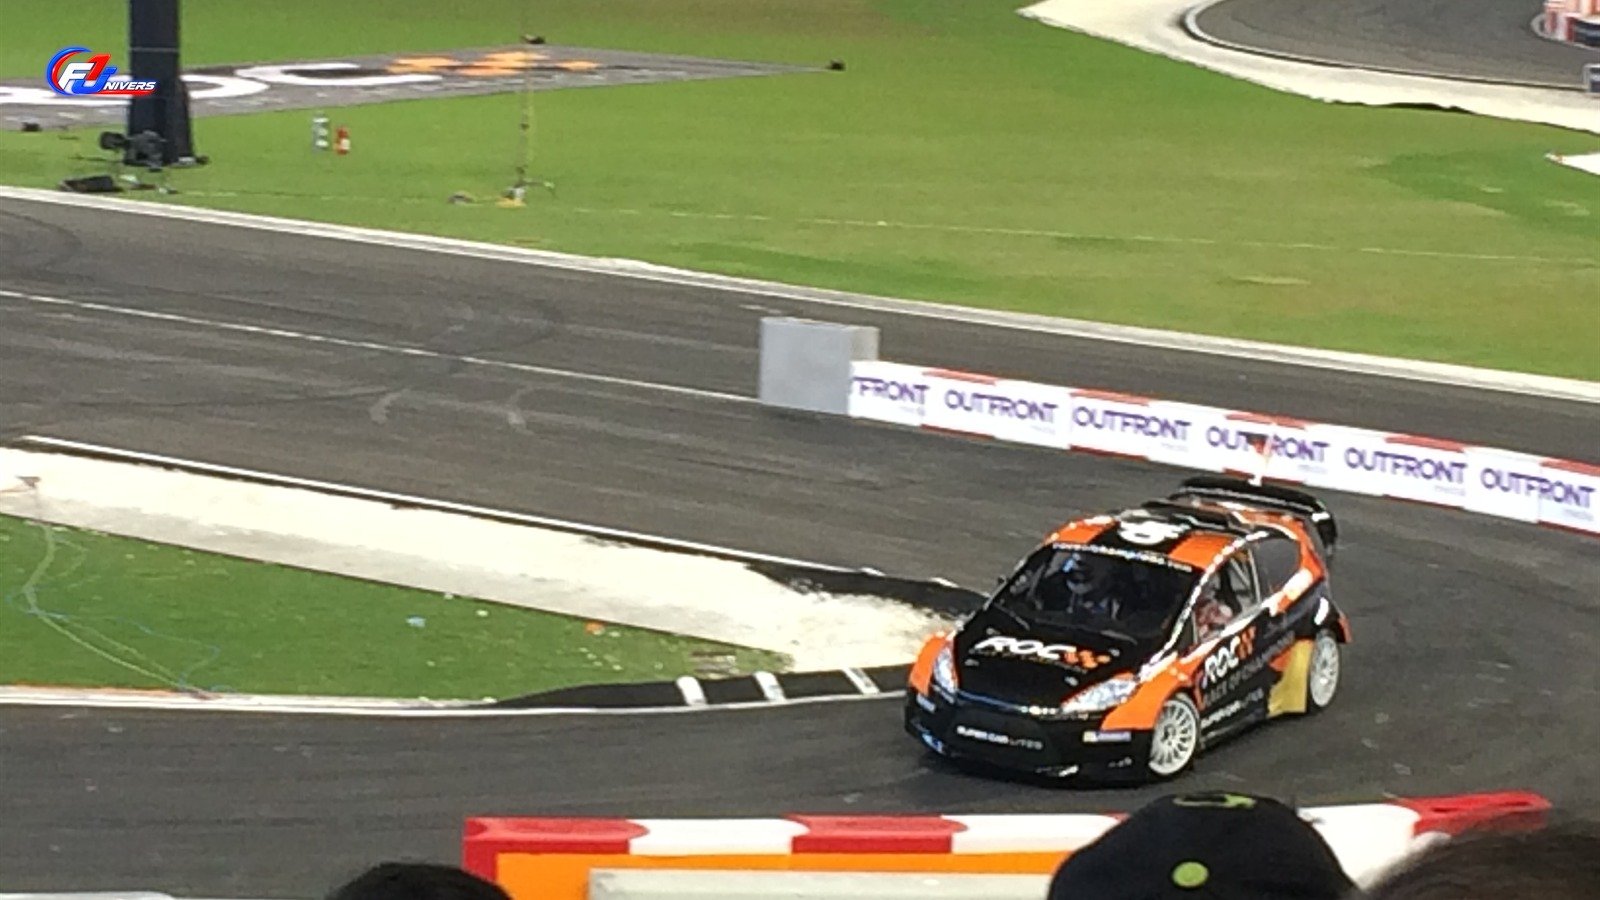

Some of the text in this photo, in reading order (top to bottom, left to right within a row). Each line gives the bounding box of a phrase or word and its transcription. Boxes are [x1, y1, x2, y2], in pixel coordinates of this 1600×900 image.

[944, 389, 1059, 424] OUTFRONT
[1072, 406, 1192, 441] OUTFRONT
[1344, 447, 1468, 485] OUTFRONT
[1480, 468, 1596, 509] OUTFRONT
[974, 636, 1077, 660] ROC
[1202, 635, 1241, 690] ROC
